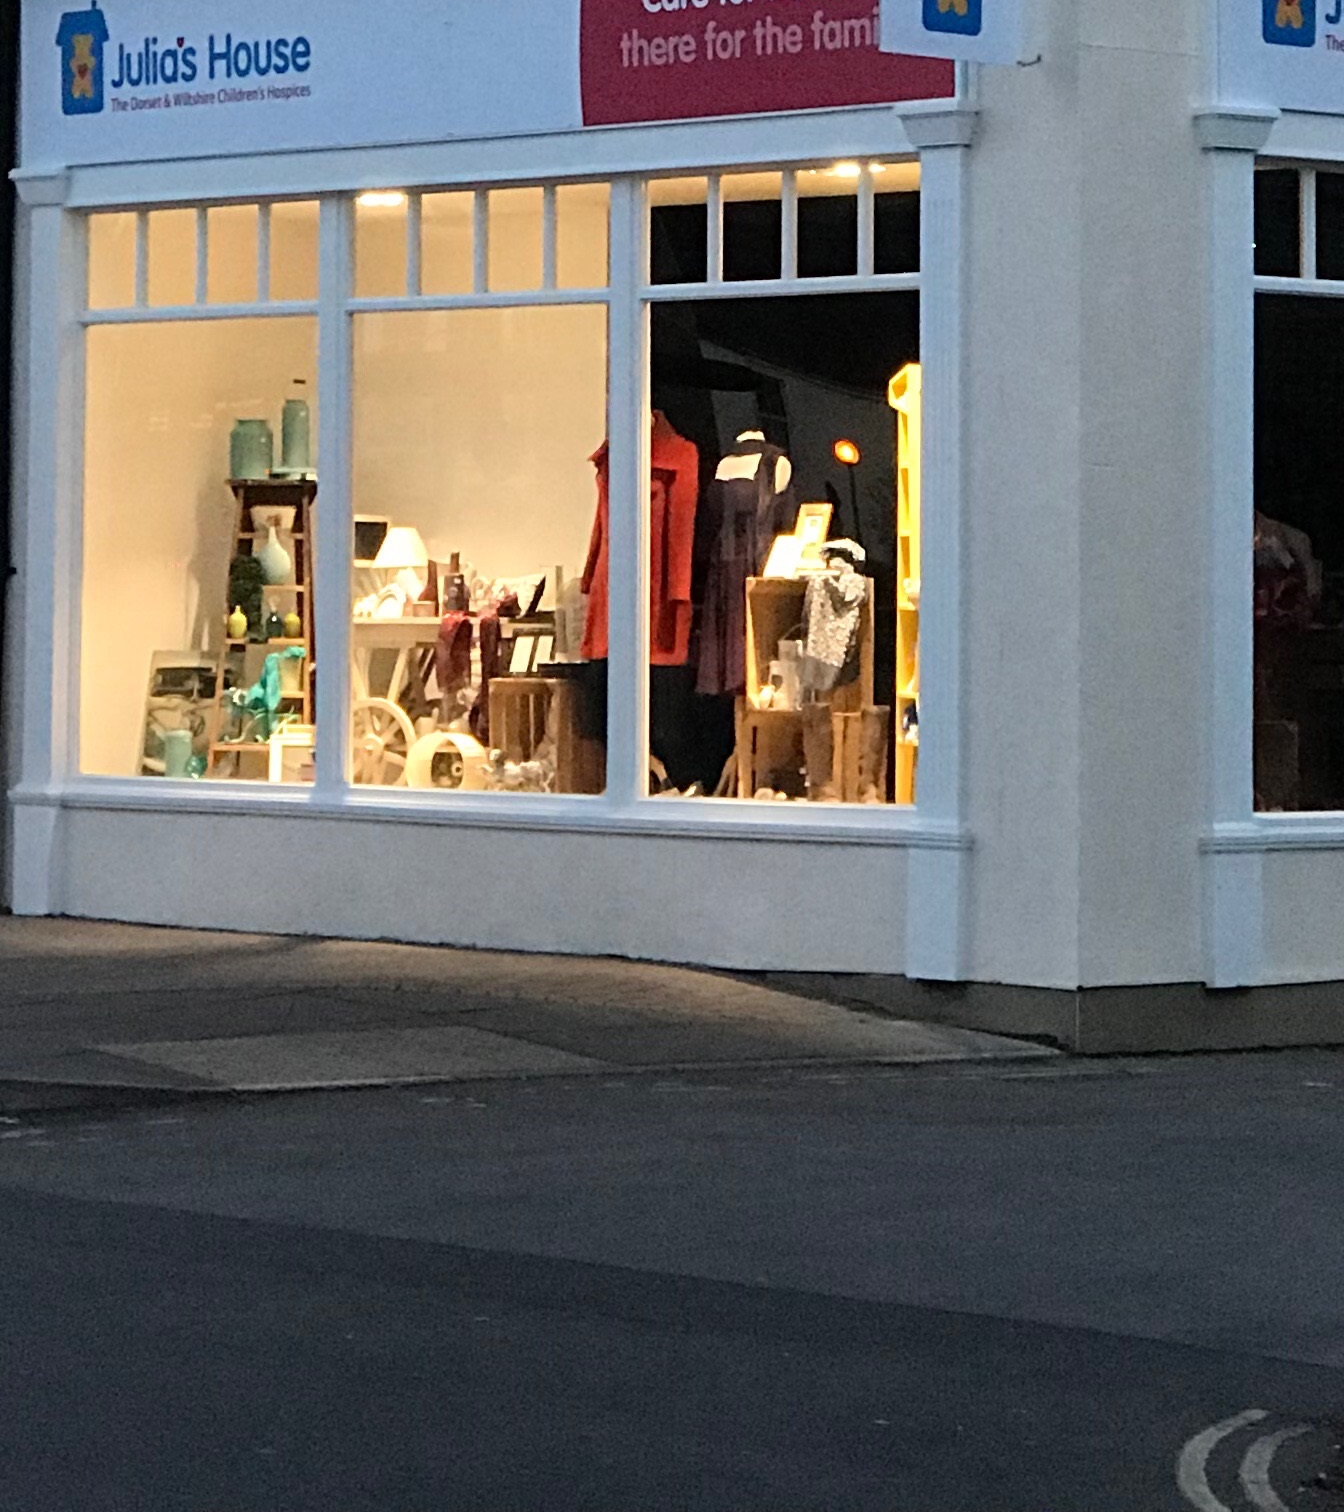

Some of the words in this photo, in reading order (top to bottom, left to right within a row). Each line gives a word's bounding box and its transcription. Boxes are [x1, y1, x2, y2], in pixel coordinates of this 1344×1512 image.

[110, 36, 197, 88] Julia's
[208, 32, 311, 80] House
[620, 28, 697, 68] there
[704, 20, 747, 61] for
[754, 16, 803, 56] the
[811, 6, 880, 51] fami
[111, 98, 129, 112] The
